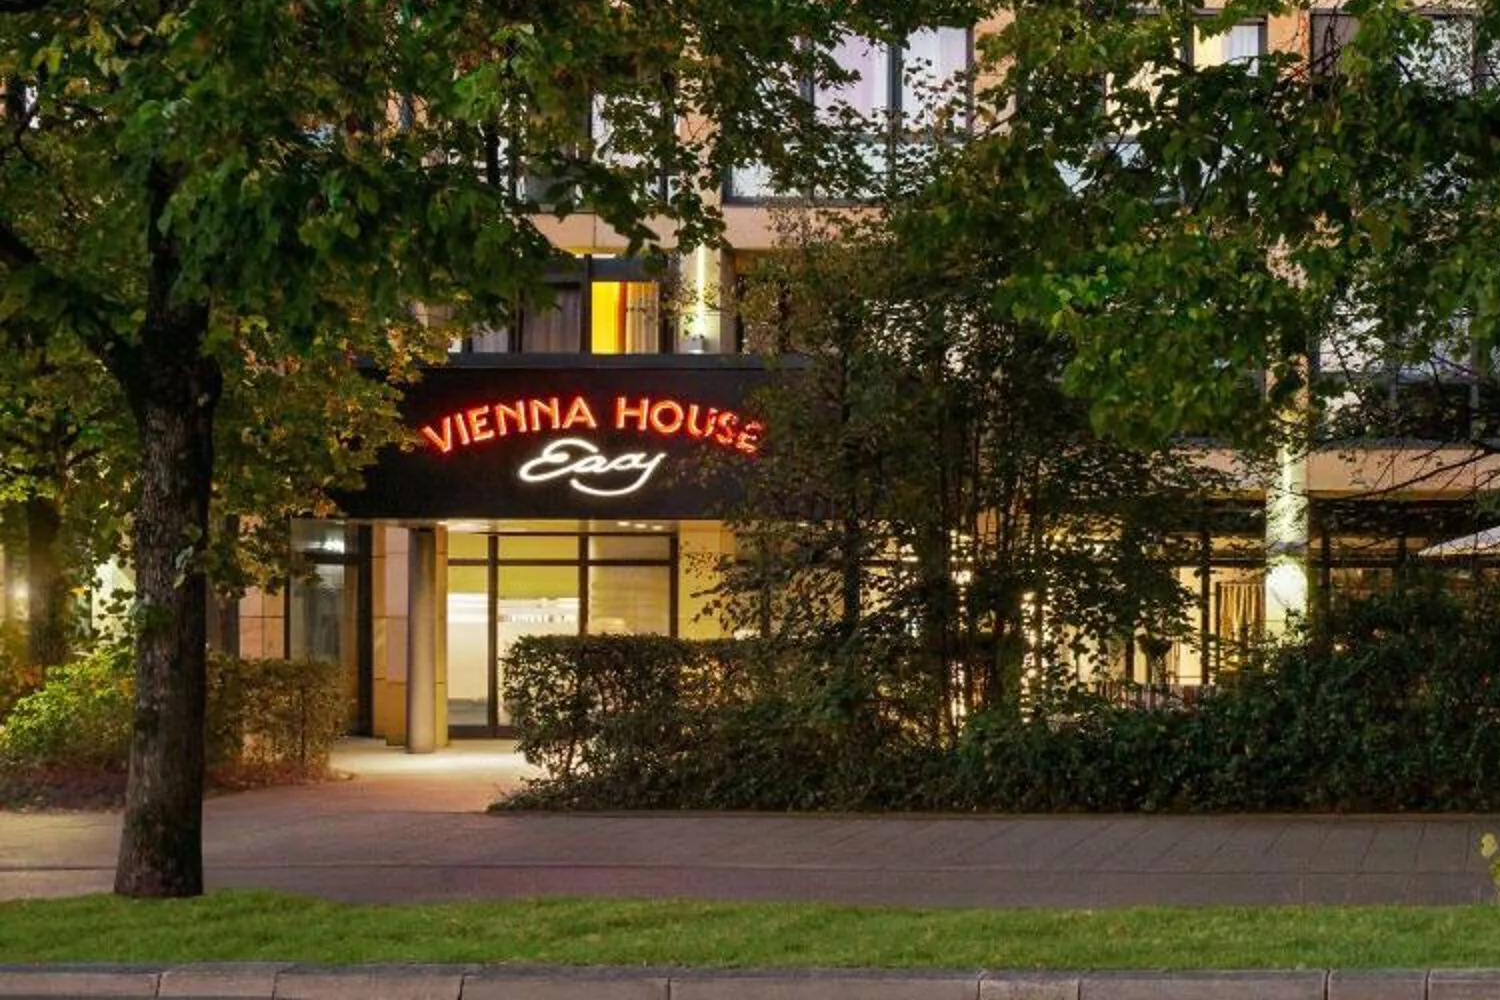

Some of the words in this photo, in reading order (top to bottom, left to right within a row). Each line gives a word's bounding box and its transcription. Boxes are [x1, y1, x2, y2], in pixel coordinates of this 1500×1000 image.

[421, 396, 597, 453] VIENNA
[615, 397, 766, 455] HOUSE
[518, 437, 666, 496] Easy
